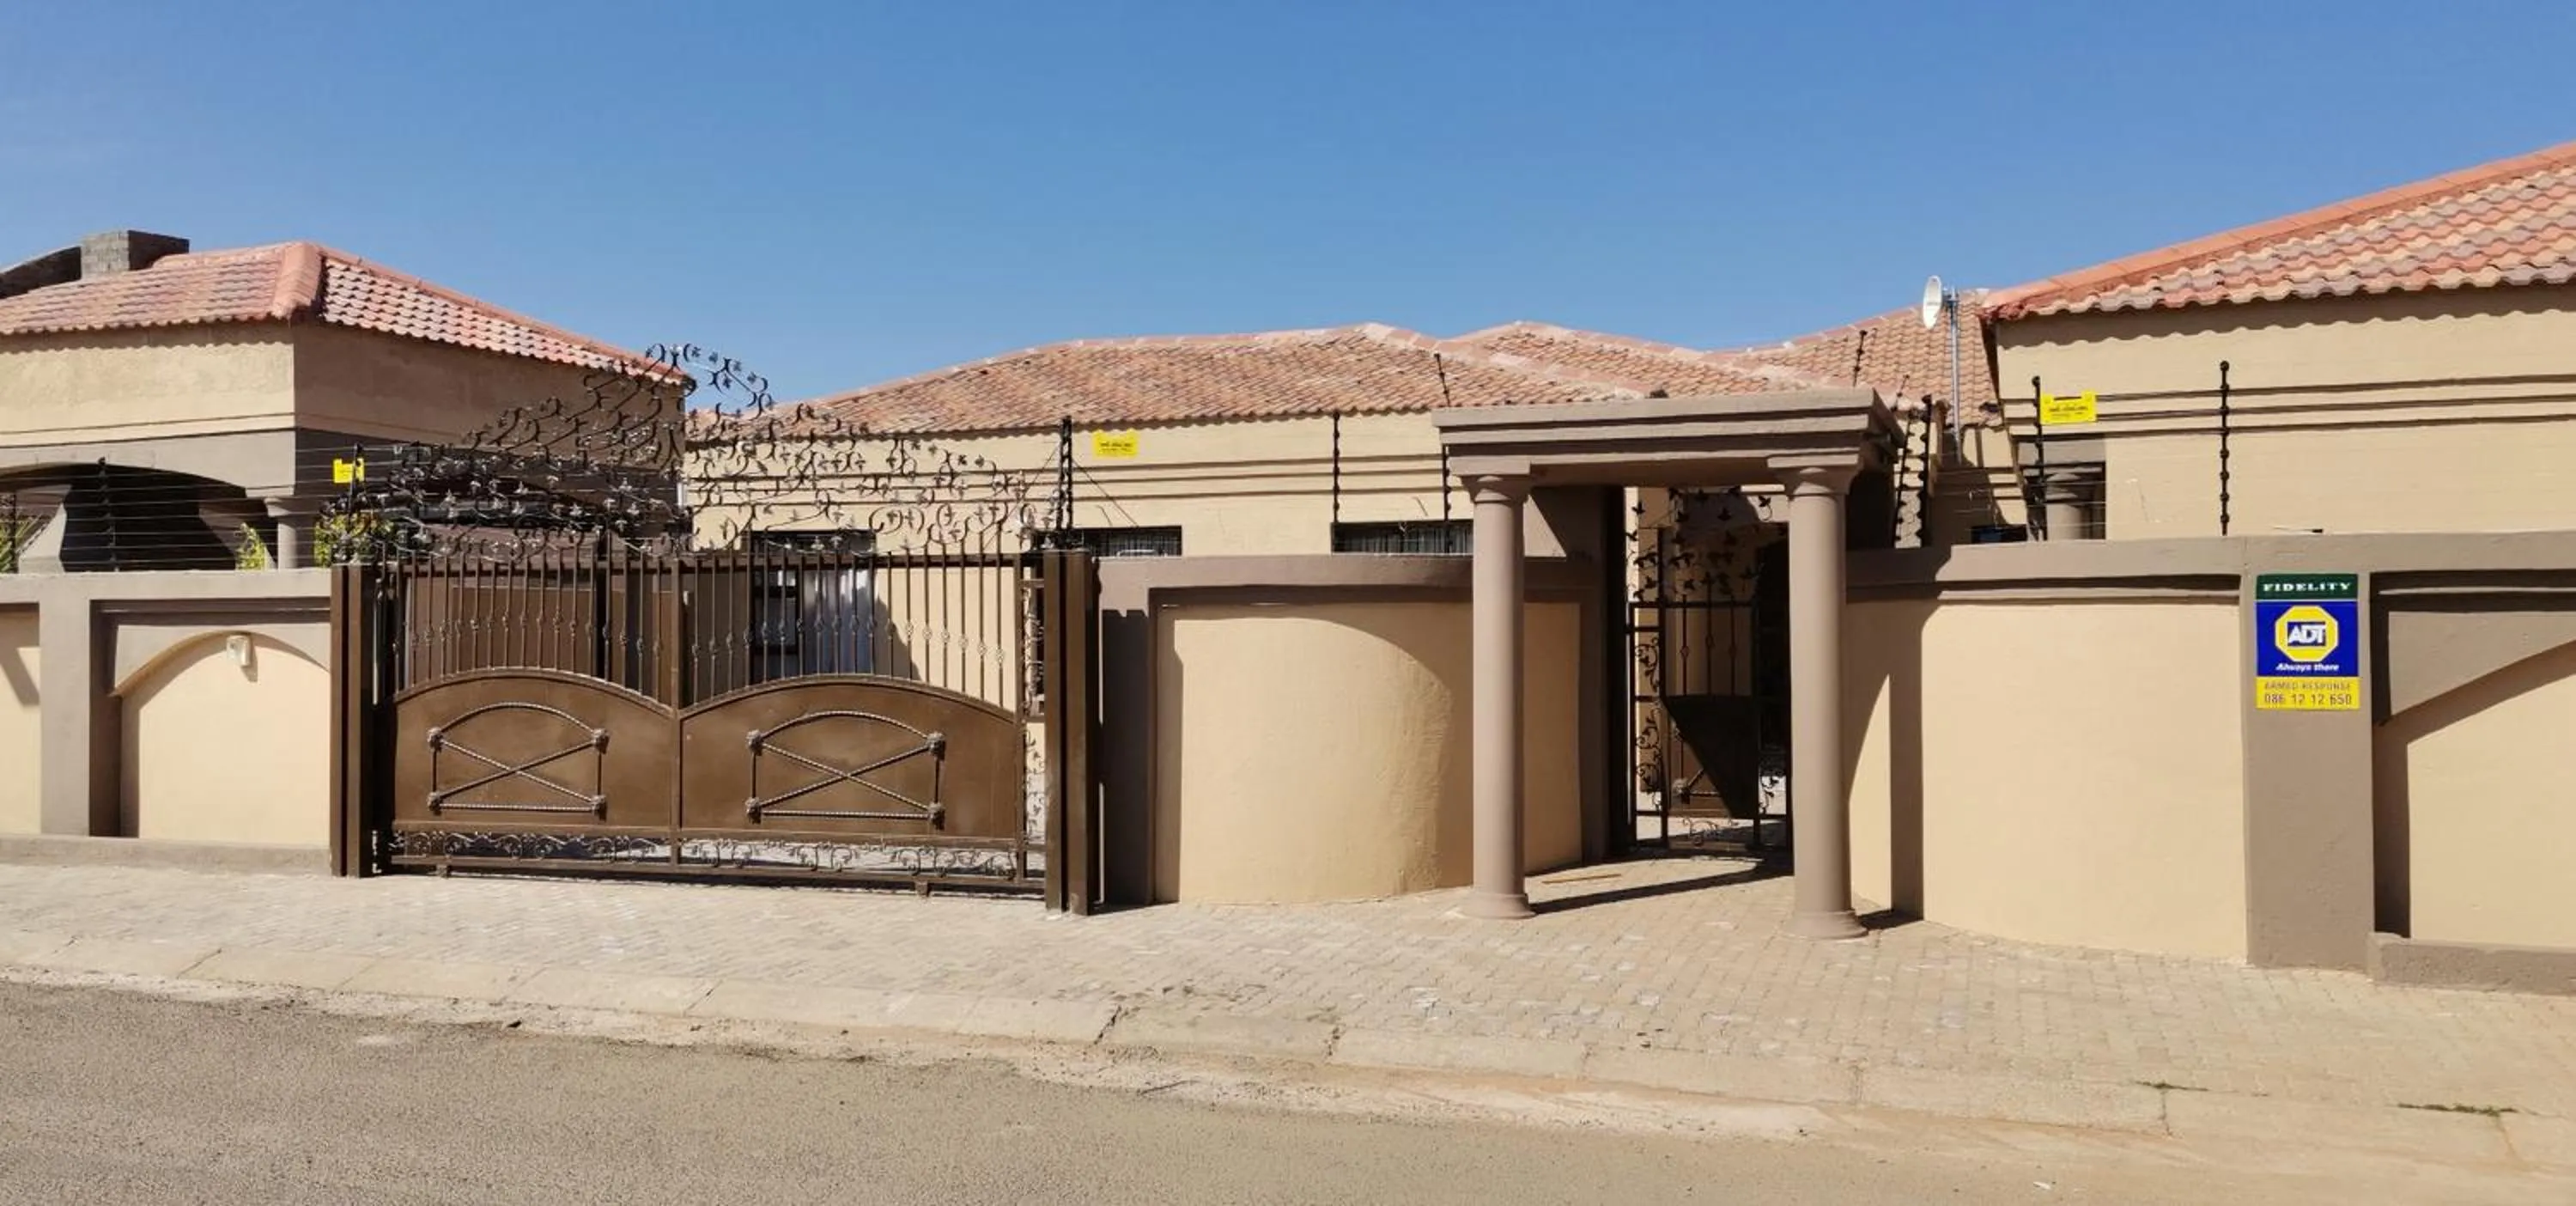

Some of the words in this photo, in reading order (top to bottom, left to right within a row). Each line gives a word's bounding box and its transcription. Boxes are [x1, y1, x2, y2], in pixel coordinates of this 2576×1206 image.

[2263, 582, 2352, 592] FIDELITY
[2287, 624, 2326, 644] ADT
[2275, 663, 2312, 673] Always
[2313, 663, 2340, 672] there
[2263, 693, 2286, 704] 086
[2291, 693, 2306, 705] 12
[2311, 693, 2325, 705] 12
